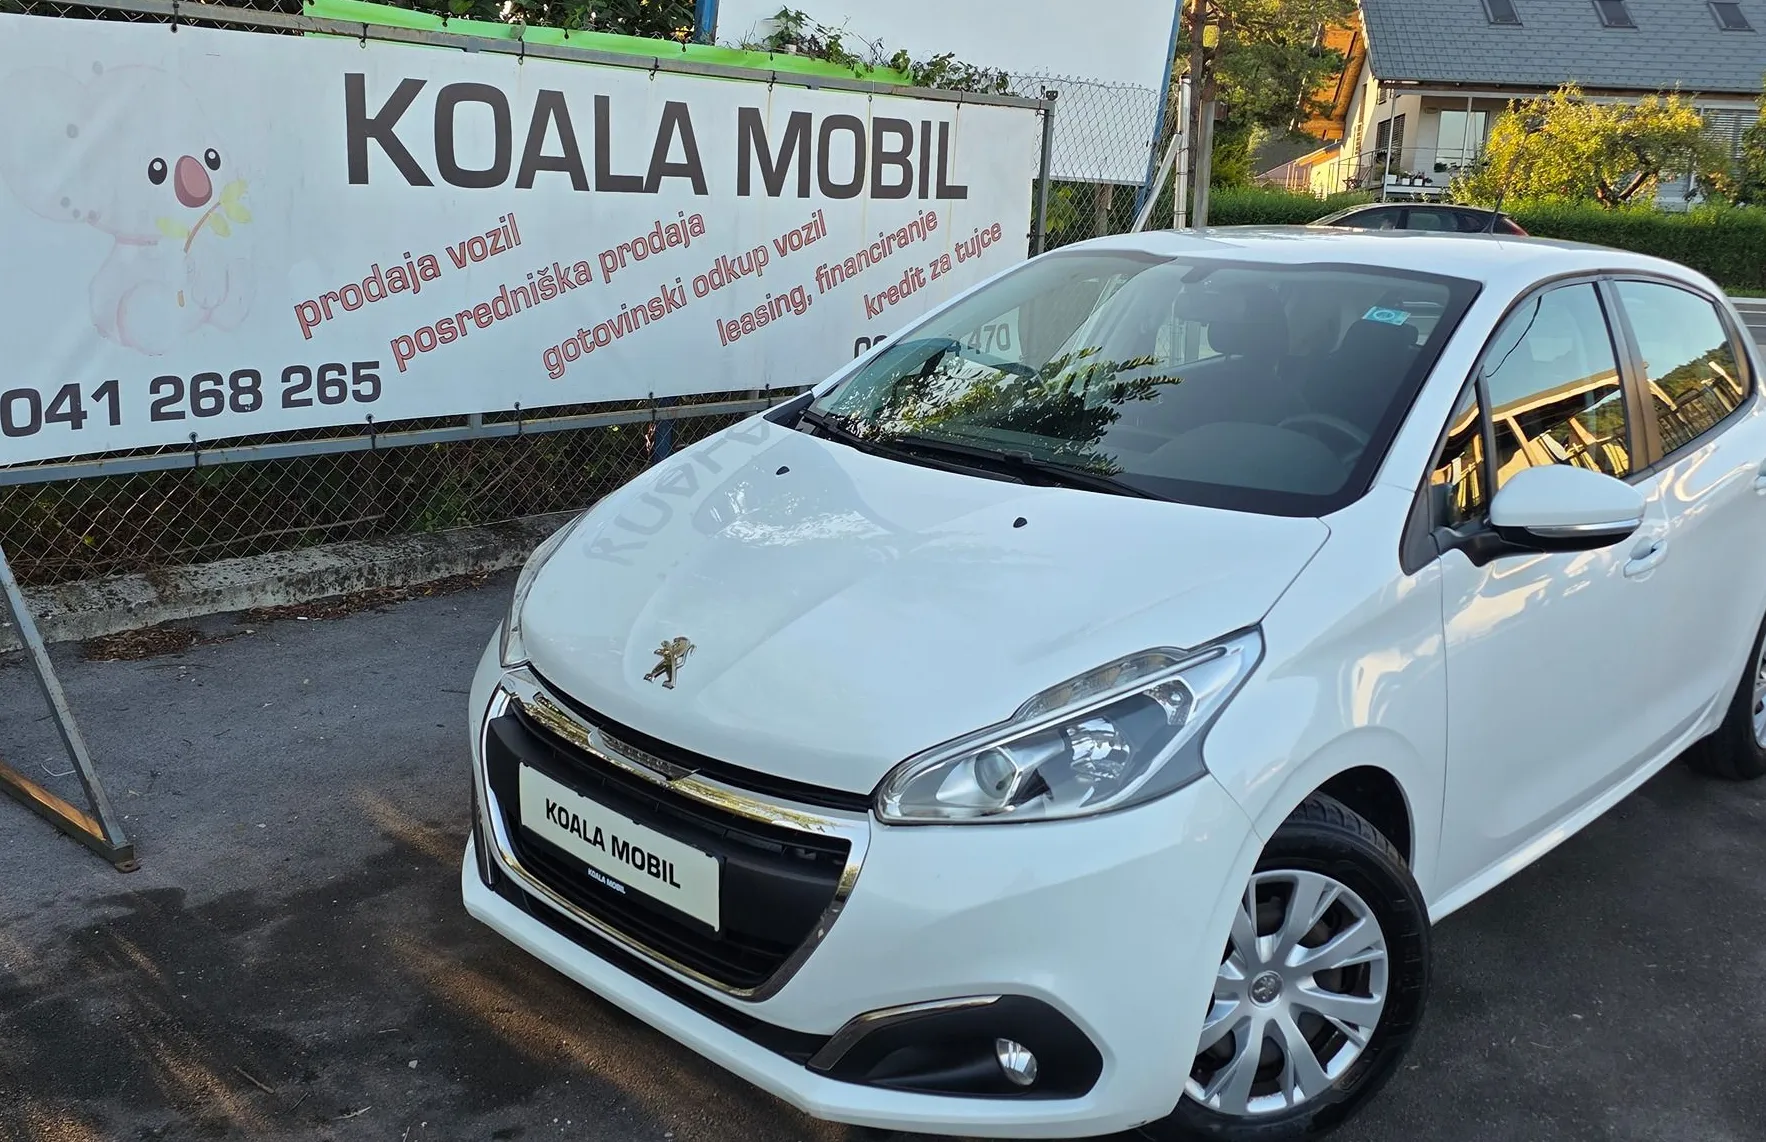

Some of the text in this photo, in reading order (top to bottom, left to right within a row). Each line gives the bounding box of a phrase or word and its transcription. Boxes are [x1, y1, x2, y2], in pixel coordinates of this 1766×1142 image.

[344, 73, 968, 200] KOALA MOBIL
[294, 214, 522, 339] prodaja vozil
[390, 212, 706, 372] posredniška prodaja
[543, 209, 827, 380] gotovinski odkup vozil
[716, 210, 938, 347] leasing, financiranje
[864, 222, 1002, 320] kredit za tujce
[967, 323, 1011, 354] 470
[0, 361, 383, 438] 041 268 265
[545, 798, 681, 889] KOALA MOBIL
[588, 867, 626, 894] KOALA MOBIL
